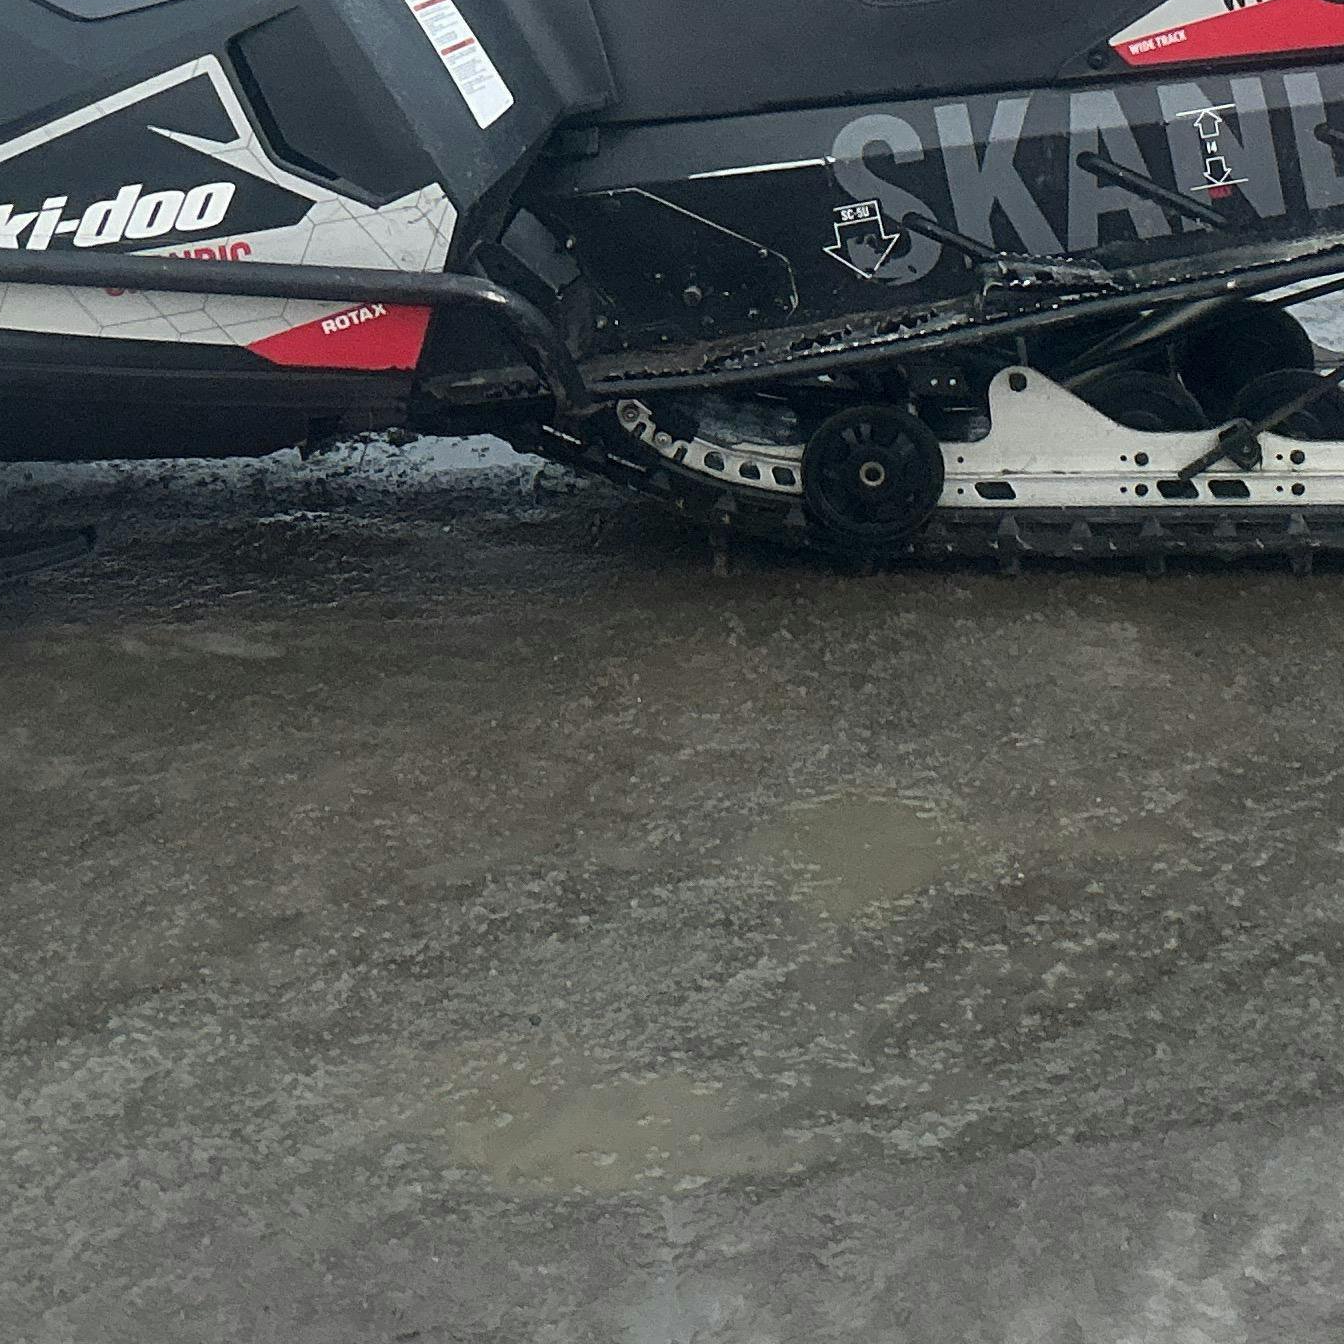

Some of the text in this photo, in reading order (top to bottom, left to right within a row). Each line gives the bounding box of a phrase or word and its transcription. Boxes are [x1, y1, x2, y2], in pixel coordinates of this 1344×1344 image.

[1128, 29, 1187, 55] WIDE TRACK
[321, 303, 387, 335] ROTAX
